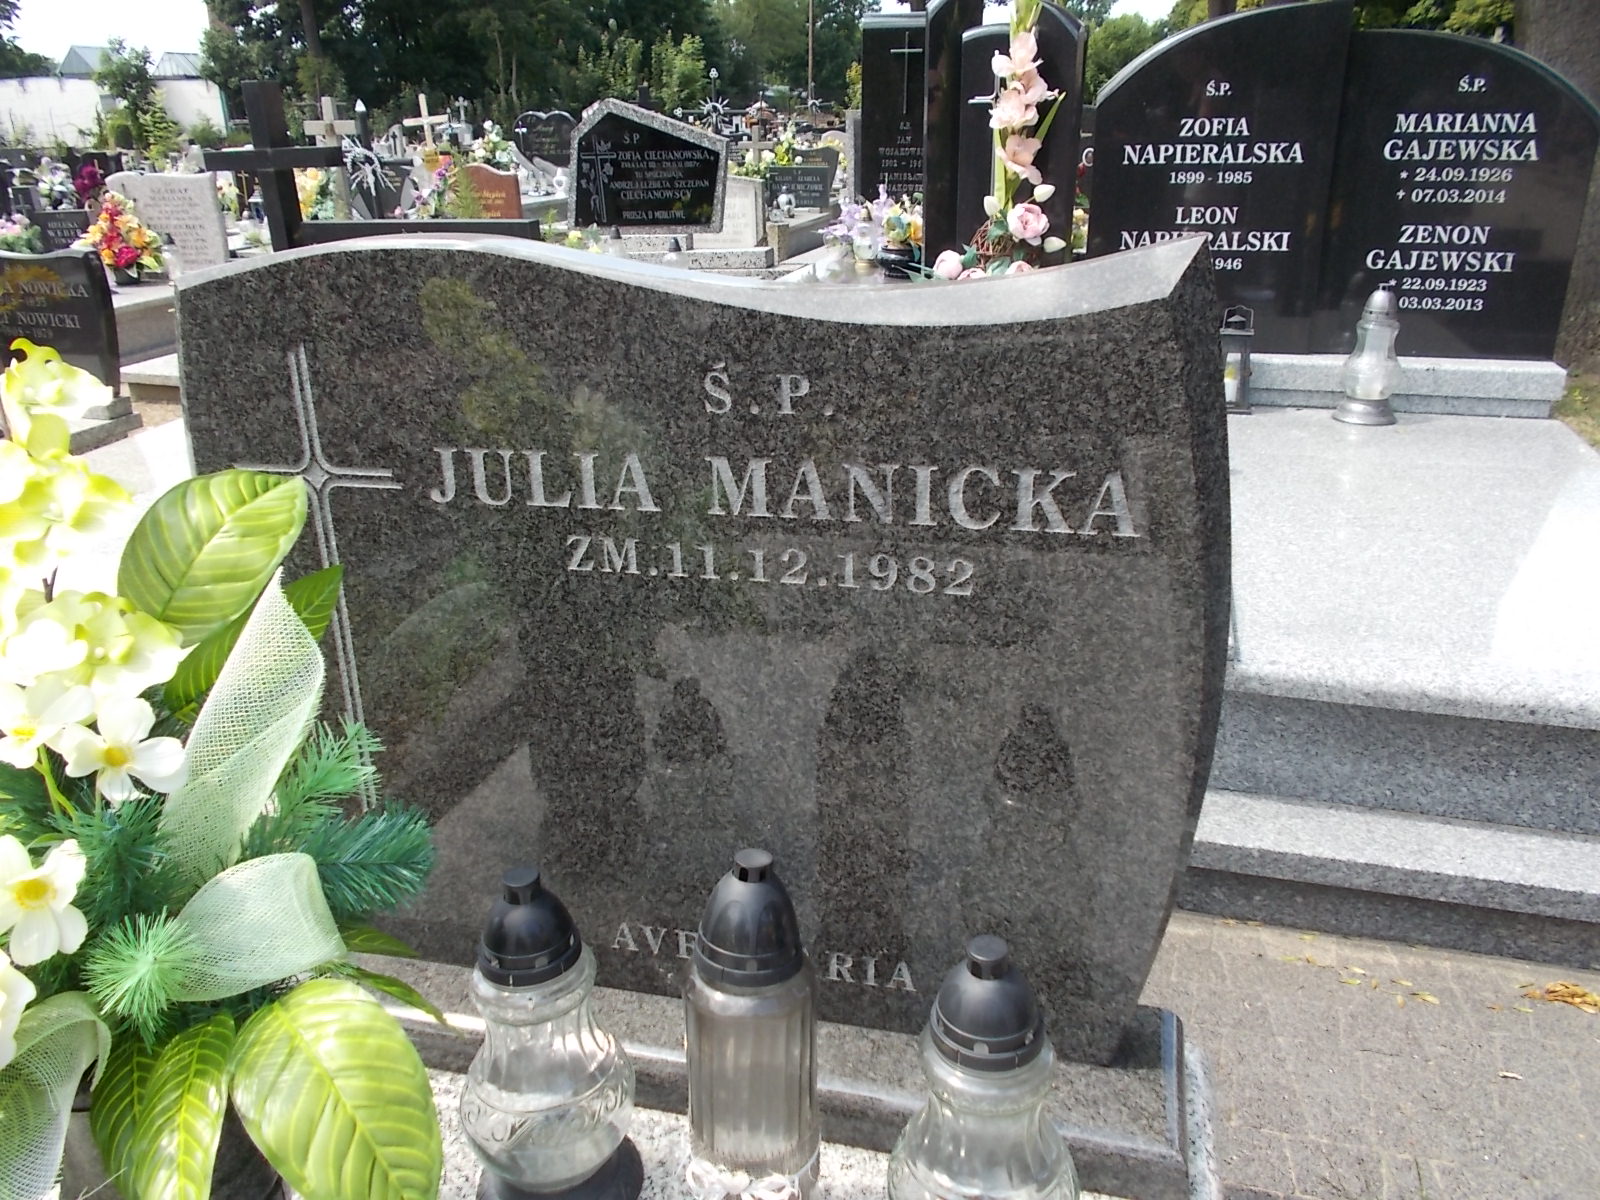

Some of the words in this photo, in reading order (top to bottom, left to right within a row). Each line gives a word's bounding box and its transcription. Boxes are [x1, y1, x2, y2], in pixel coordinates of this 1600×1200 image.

[1206, 80, 1232, 97] Ś.P.
[1458, 75, 1487, 92] Ś.P.
[1178, 117, 1250, 137] ZOFIA
[1394, 113, 1537, 133] MARIANNA
[617, 150, 641, 160] ZOFIA
[1122, 142, 1304, 165] NAPIERALSKA
[1383, 139, 1539, 161] GAJEWSKA
[1169, 171, 1205, 184] 1899
[1217, 171, 1253, 184] 1985
[1414, 167, 1513, 182] 24.09.1926
[1411, 188, 1506, 203] 07.03.2014
[1175, 206, 1238, 224] LEON
[1119, 231, 1291, 252] NAPRALSKI
[1399, 225, 1491, 245] ZENON
[1210, 257, 1243, 270] 946
[1366, 249, 1516, 273] GAJEWSKI
[1401, 277, 1488, 292] 22.09.1923
[1398, 296, 1484, 311] 03.03.2013
[16, 312, 81, 328] NOWICKI
[429, 446, 662, 513] JULIA
[704, 455, 1142, 539] MANICKA
[566, 534, 976, 598] ZM.11.12.1982
[815, 948, 918, 992] RIA
